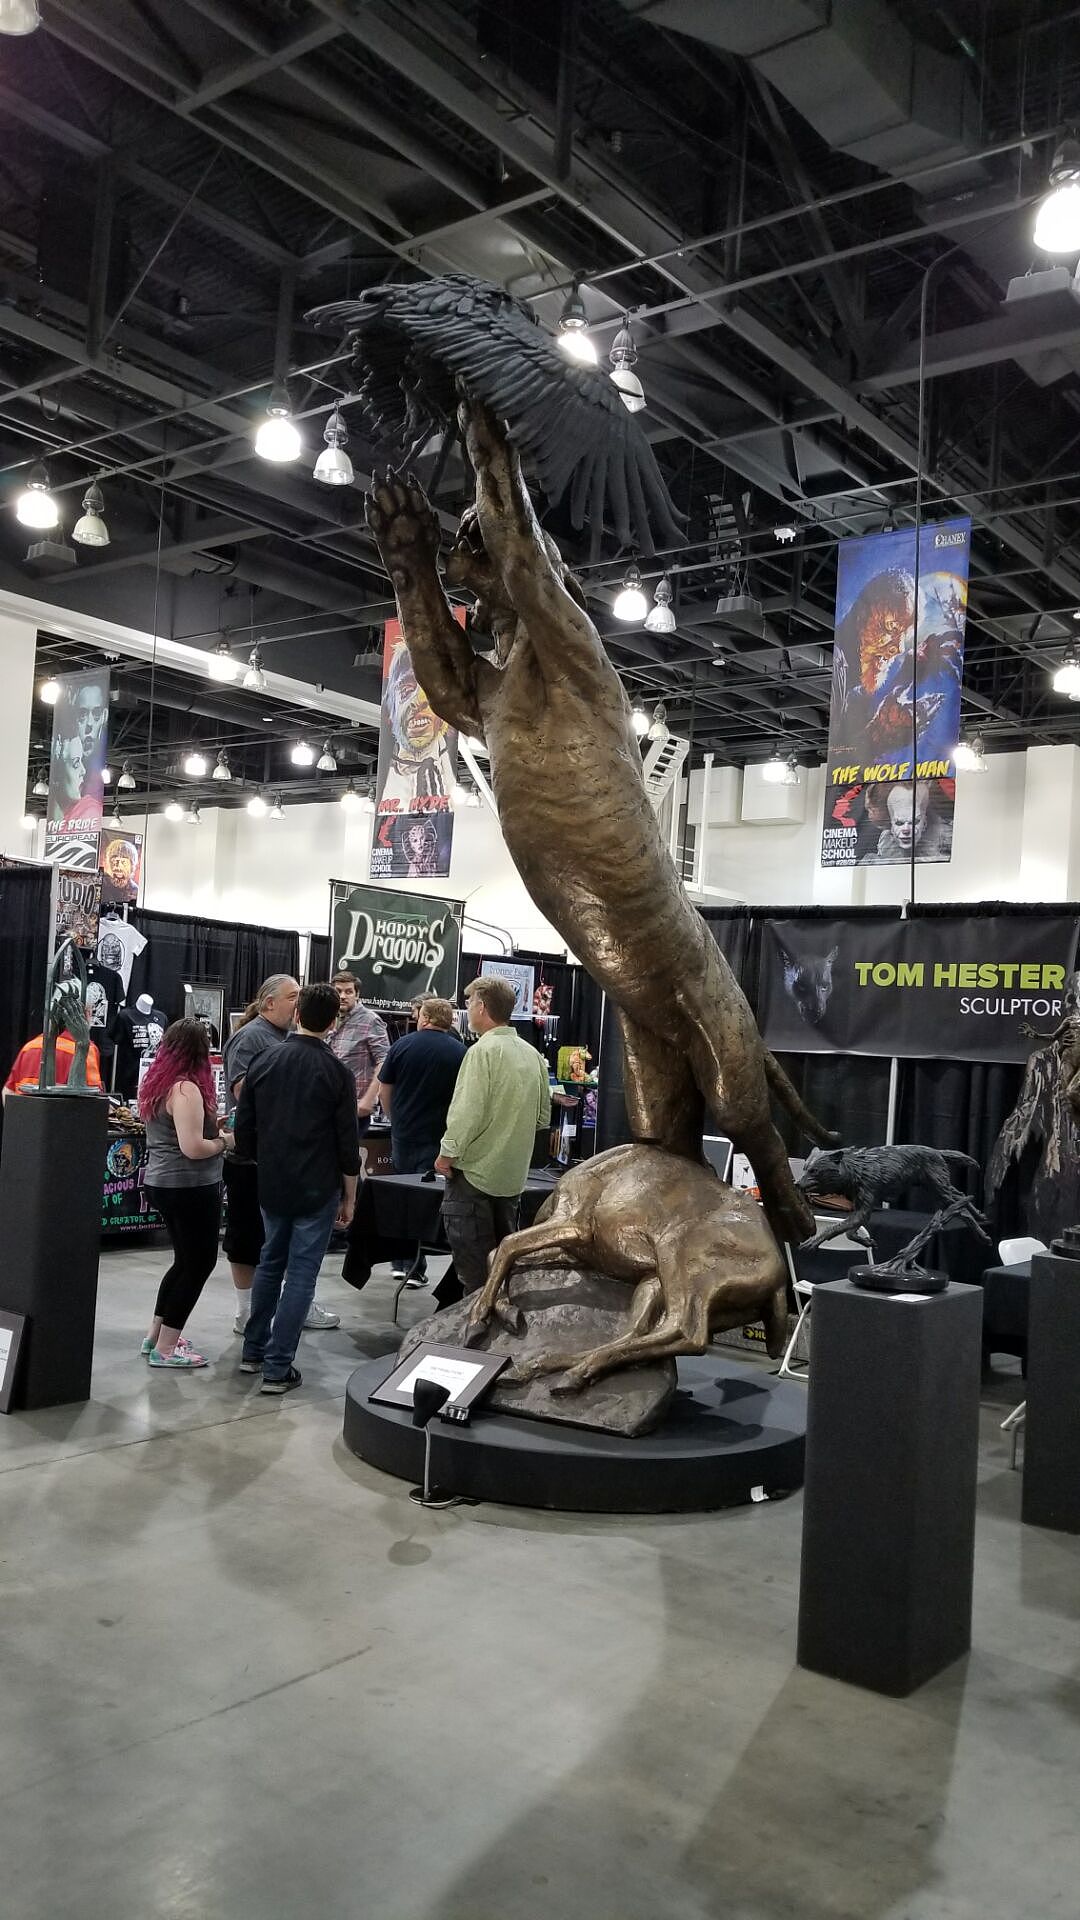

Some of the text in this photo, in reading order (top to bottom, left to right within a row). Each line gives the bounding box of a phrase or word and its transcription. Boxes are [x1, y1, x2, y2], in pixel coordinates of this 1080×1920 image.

[832, 760, 950, 784] THE WOLF MAN
[378, 795, 449, 812] MR. HYDE
[48, 819, 98, 831] THE BRIDE
[46, 834, 98, 842] EUROPEAN
[823, 828, 858, 838] CINEMA
[823, 838, 857, 849] MAKEUP
[371, 848, 393, 856] CINEMA
[822, 848, 857, 859] SCHOOL
[370, 864, 393, 873] SCHOOL
[854, 962, 1066, 990] TOM HESTER
[960, 997, 1062, 1017] SCULPTOR
[112, 1193, 123, 1204] OF
